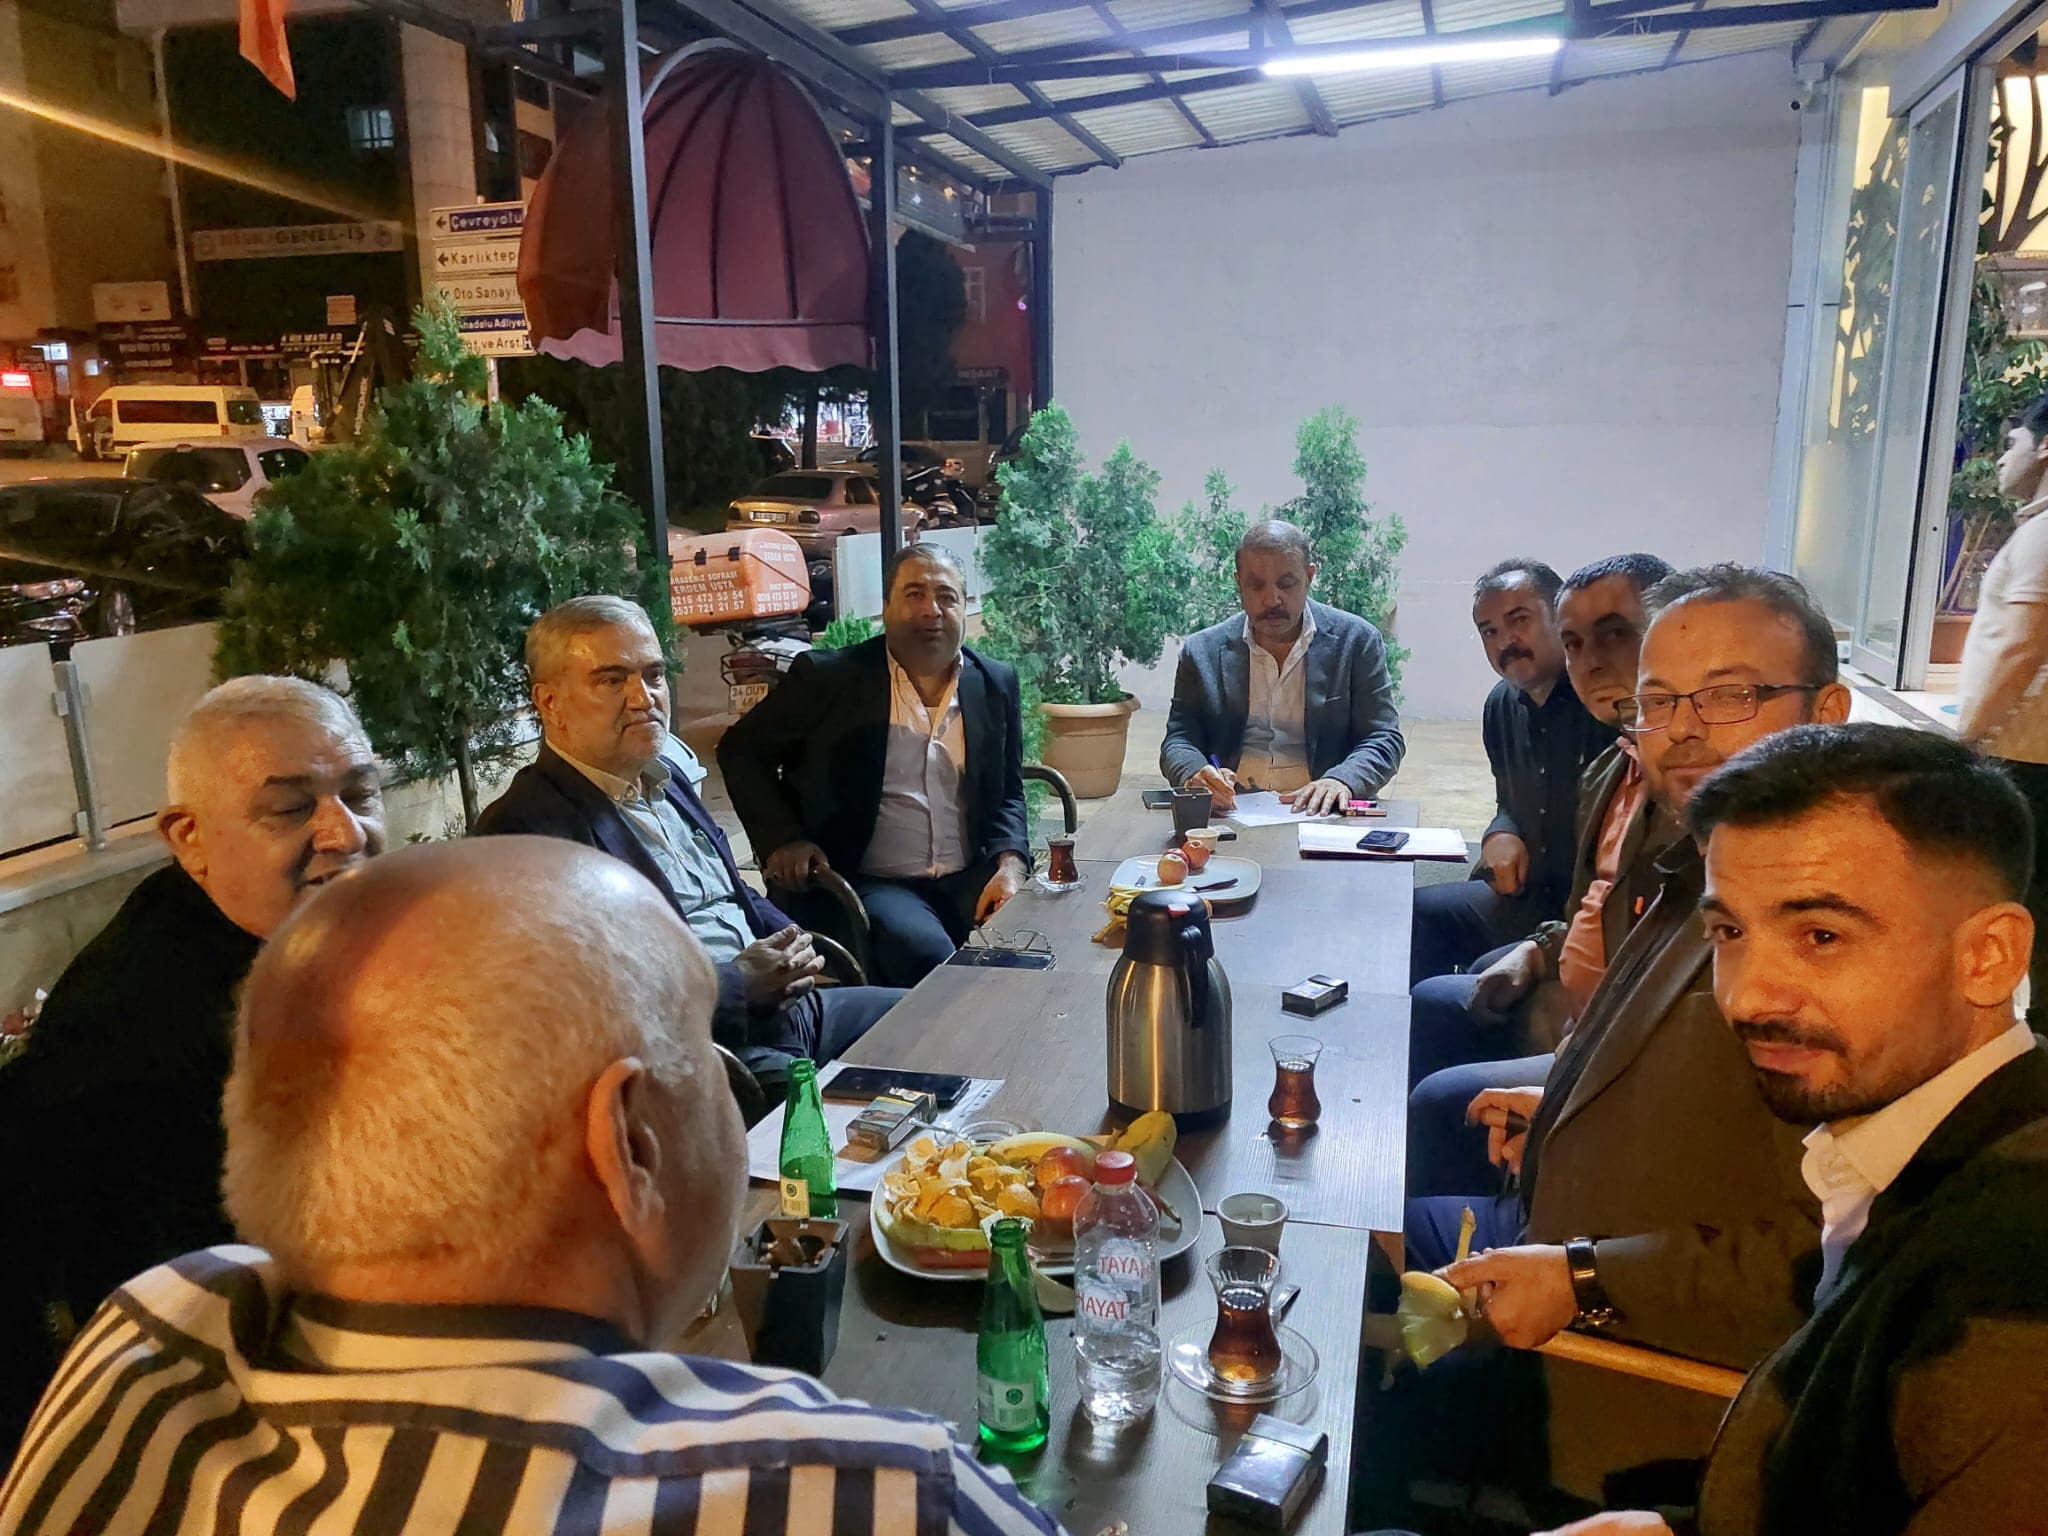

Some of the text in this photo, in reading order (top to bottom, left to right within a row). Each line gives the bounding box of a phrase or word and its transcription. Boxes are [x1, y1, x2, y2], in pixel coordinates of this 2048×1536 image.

[451, 211, 522, 231] Çevreyolu
[451, 250, 517, 264] Karlıktep
[454, 286, 472, 299] Oto
[494, 317, 526, 329] Adliyes
[481, 340, 494, 349] ve
[673, 582, 707, 595] ERDEM
[696, 592, 713, 603] 473
[697, 602, 714, 614] 721
[718, 601, 729, 612] 21
[733, 600, 744, 611] 57
[1075, 1290, 1127, 1320] HAYAT
